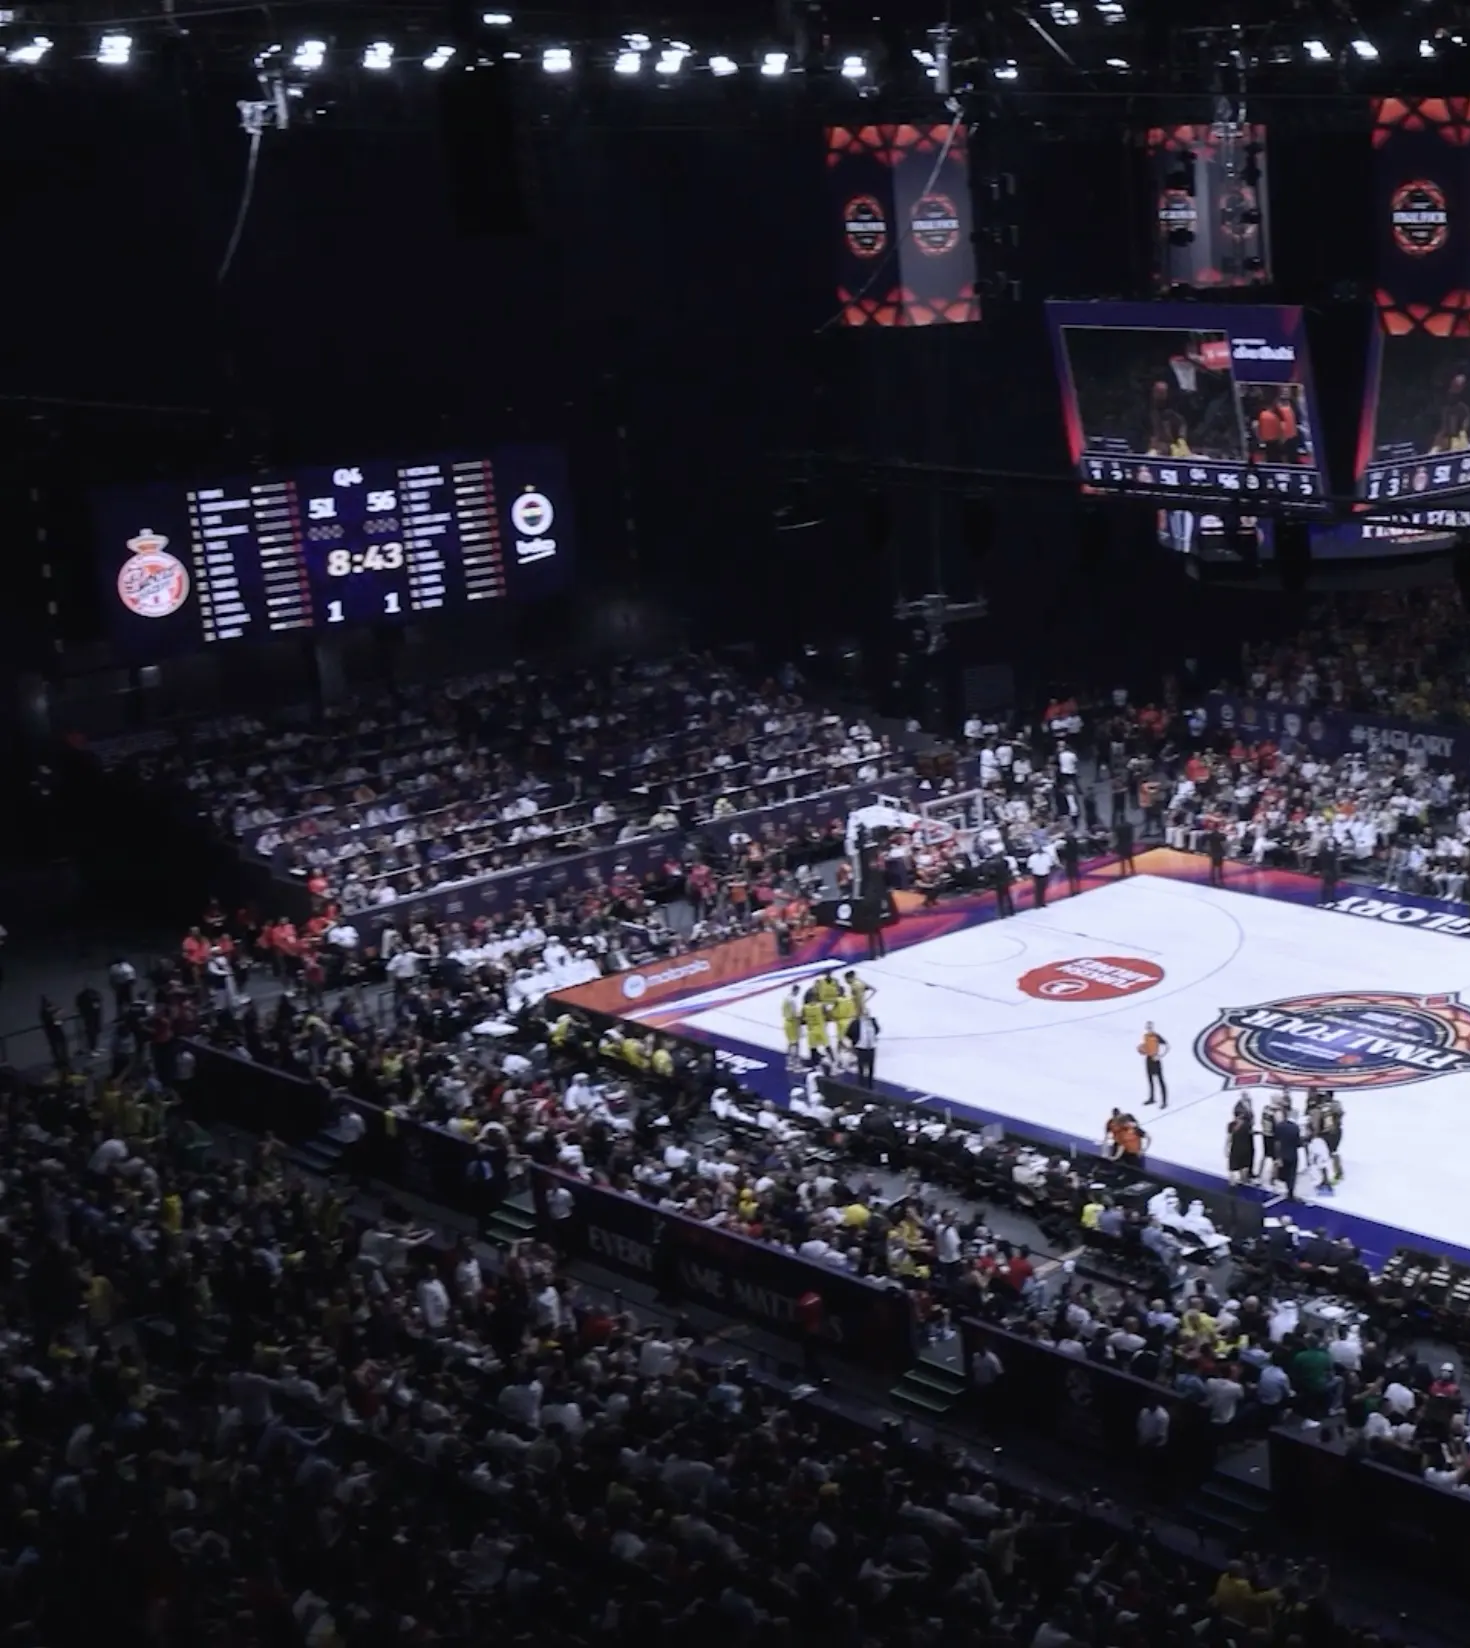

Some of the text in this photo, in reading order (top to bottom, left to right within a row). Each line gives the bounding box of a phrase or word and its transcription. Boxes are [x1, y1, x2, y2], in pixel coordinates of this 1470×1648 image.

[333, 467, 363, 487] Q4
[1368, 481, 1381, 499] 1
[1386, 477, 1400, 496] 3
[308, 490, 397, 519] 51 56
[327, 542, 404, 576] 8:43
[327, 592, 401, 622] 1 1
[1241, 1010, 1348, 1043] FOUR
[1345, 1033, 1463, 1069] FINAL
[588, 1224, 654, 1273] EVERY
[734, 1278, 844, 1343] MATTS
